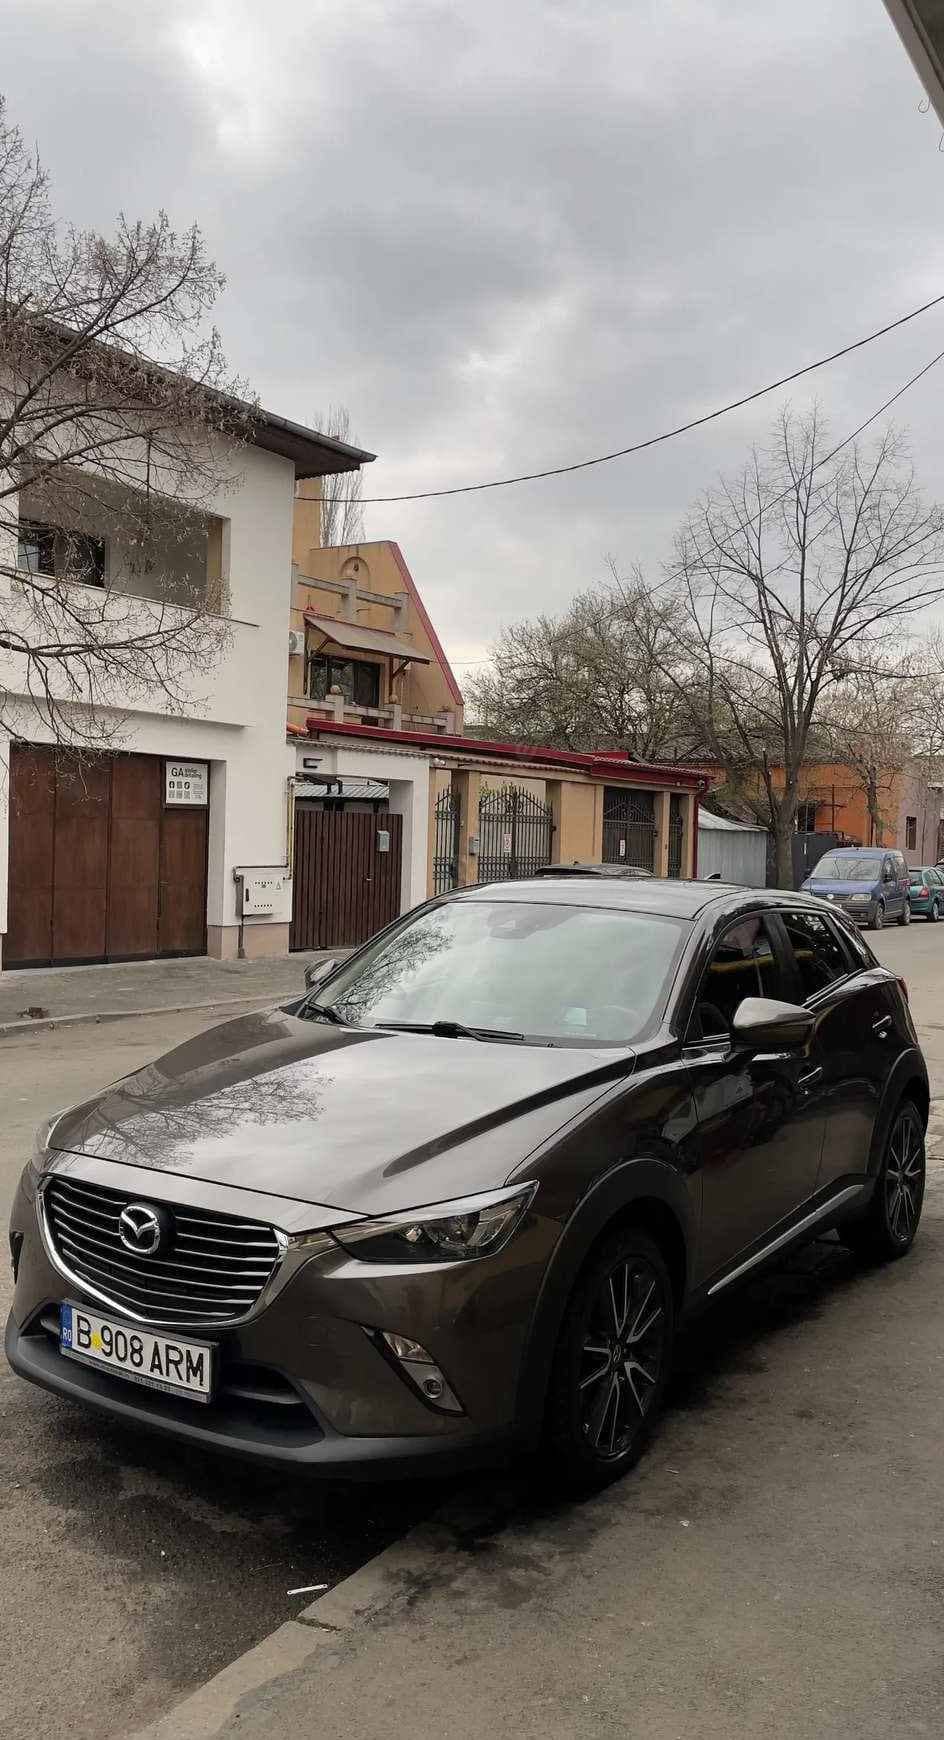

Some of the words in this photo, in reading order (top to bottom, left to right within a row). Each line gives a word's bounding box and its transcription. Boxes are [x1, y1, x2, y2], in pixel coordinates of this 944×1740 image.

[171, 767, 184, 777] GA
[62, 1327, 72, 1342] RO
[76, 1314, 92, 1349] B
[100, 1325, 144, 1368] 908
[150, 1341, 205, 1387] ARM
